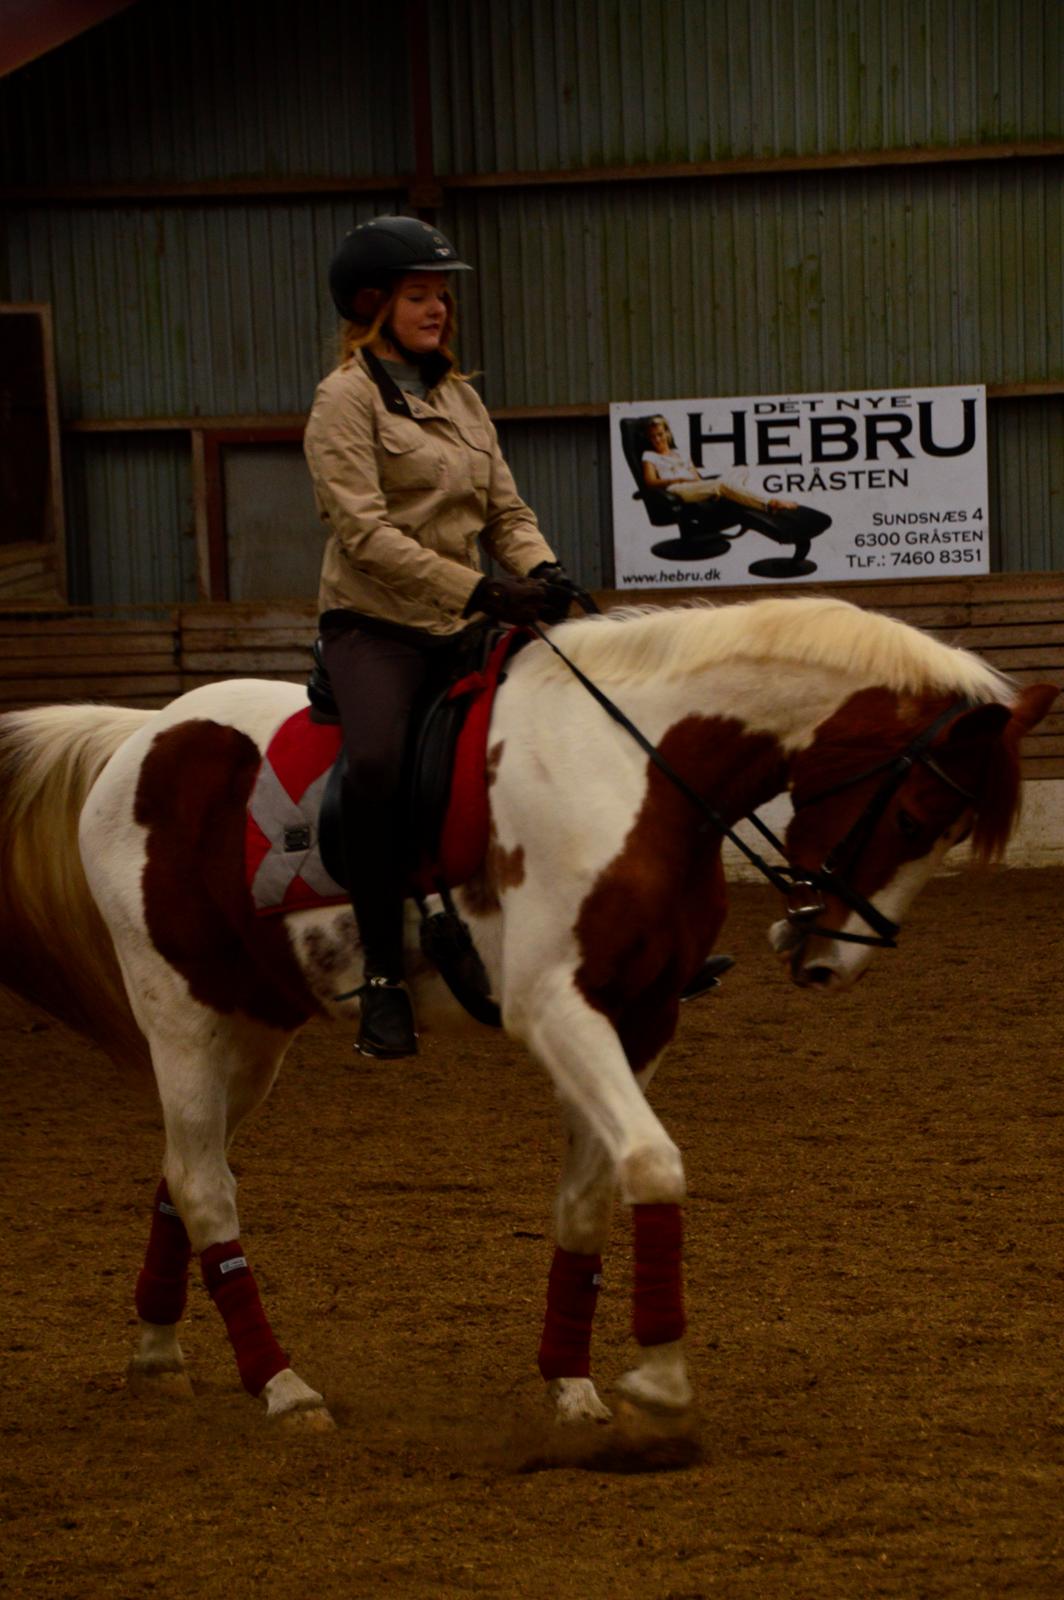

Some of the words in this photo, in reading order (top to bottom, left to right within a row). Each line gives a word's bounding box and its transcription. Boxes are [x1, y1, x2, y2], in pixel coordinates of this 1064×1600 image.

[754, 400, 824, 415] DET
[836, 395, 913, 411] NYE
[687, 398, 977, 468] HEBRU
[763, 467, 909, 494] GRÅSTEN
[872, 510, 968, 526] SUNDSNÆS
[971, 508, 984, 522] 4
[854, 532, 900, 548] 6300
[904, 529, 984, 545] GRÅSTEN
[890, 551, 935, 567] 7460
[939, 548, 983, 565] 8351
[622, 569, 721, 584] www.hebru.dk
